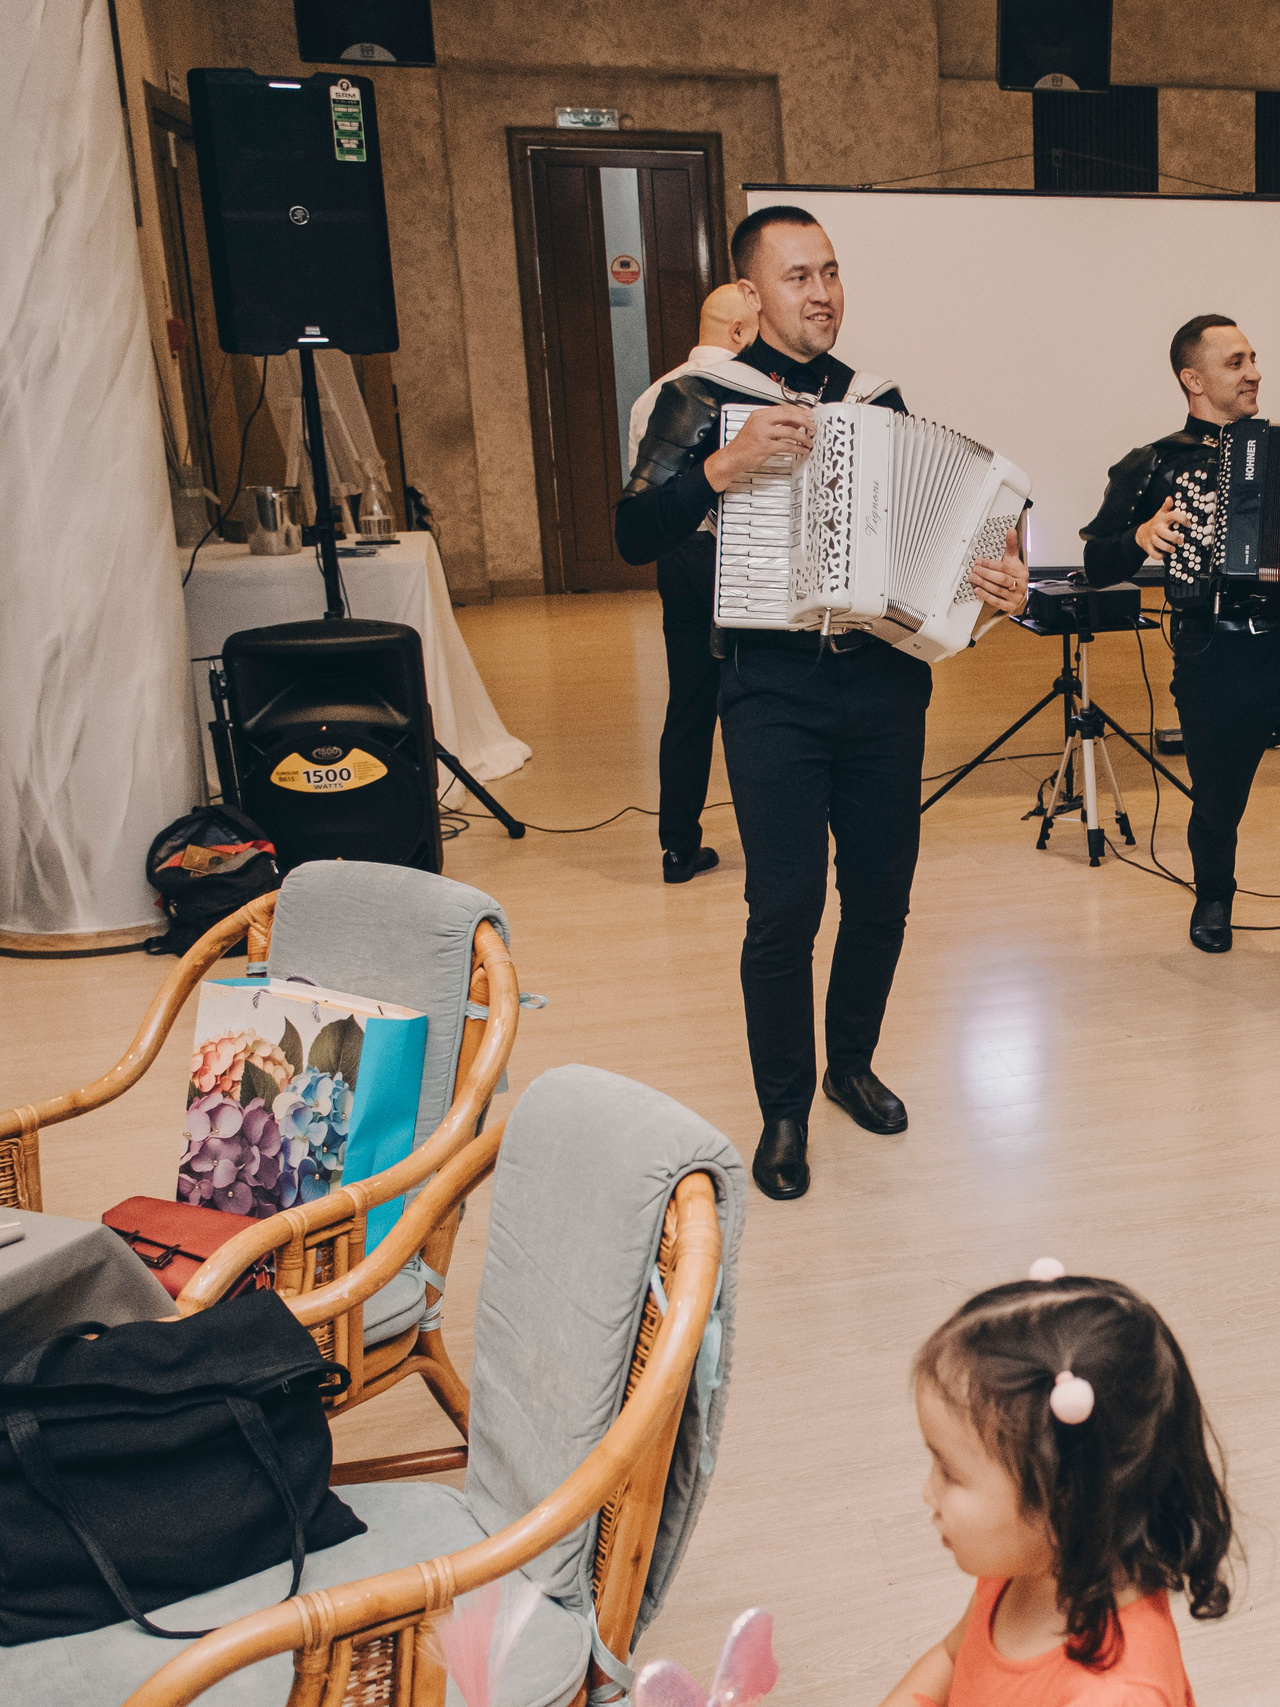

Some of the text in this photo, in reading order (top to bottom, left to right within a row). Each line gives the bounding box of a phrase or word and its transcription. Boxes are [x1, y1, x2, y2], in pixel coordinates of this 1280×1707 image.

[1245, 439, 1257, 481] HOHNER
[864, 478, 881, 537] Vignoni
[302, 767, 352, 784] 1500
